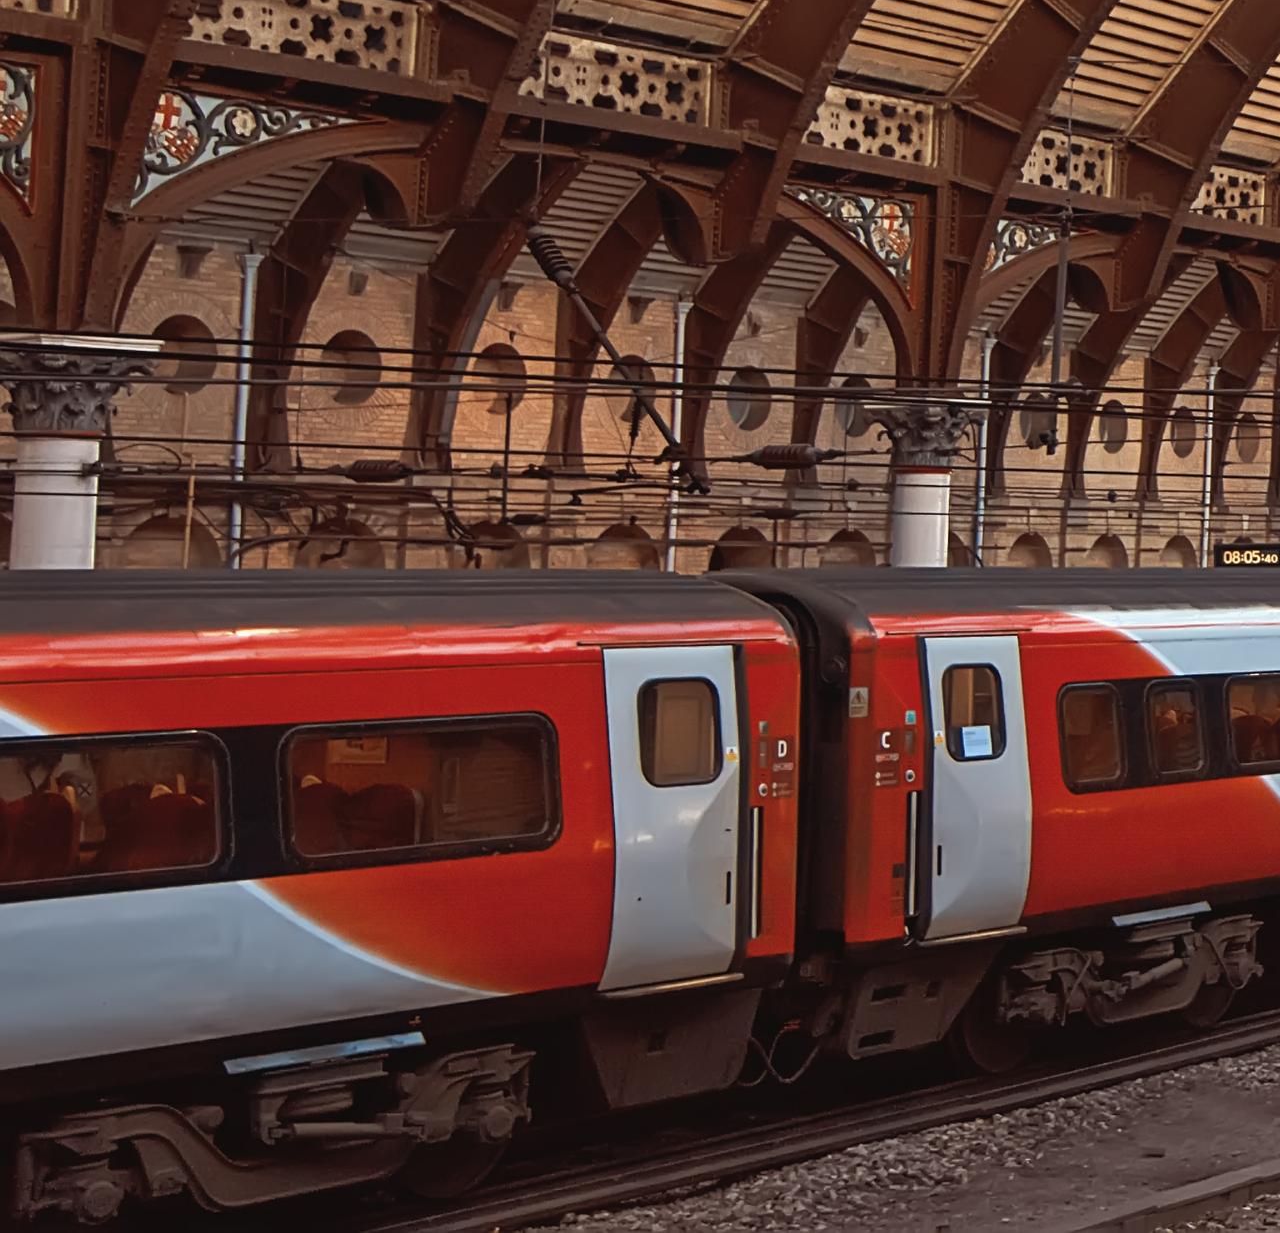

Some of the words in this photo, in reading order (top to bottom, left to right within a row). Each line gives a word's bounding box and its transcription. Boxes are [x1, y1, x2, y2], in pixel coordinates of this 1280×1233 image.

[1223, 550, 1279, 564] 08:05:40
[777, 739, 788, 758] D
[881, 731, 892, 749] C
